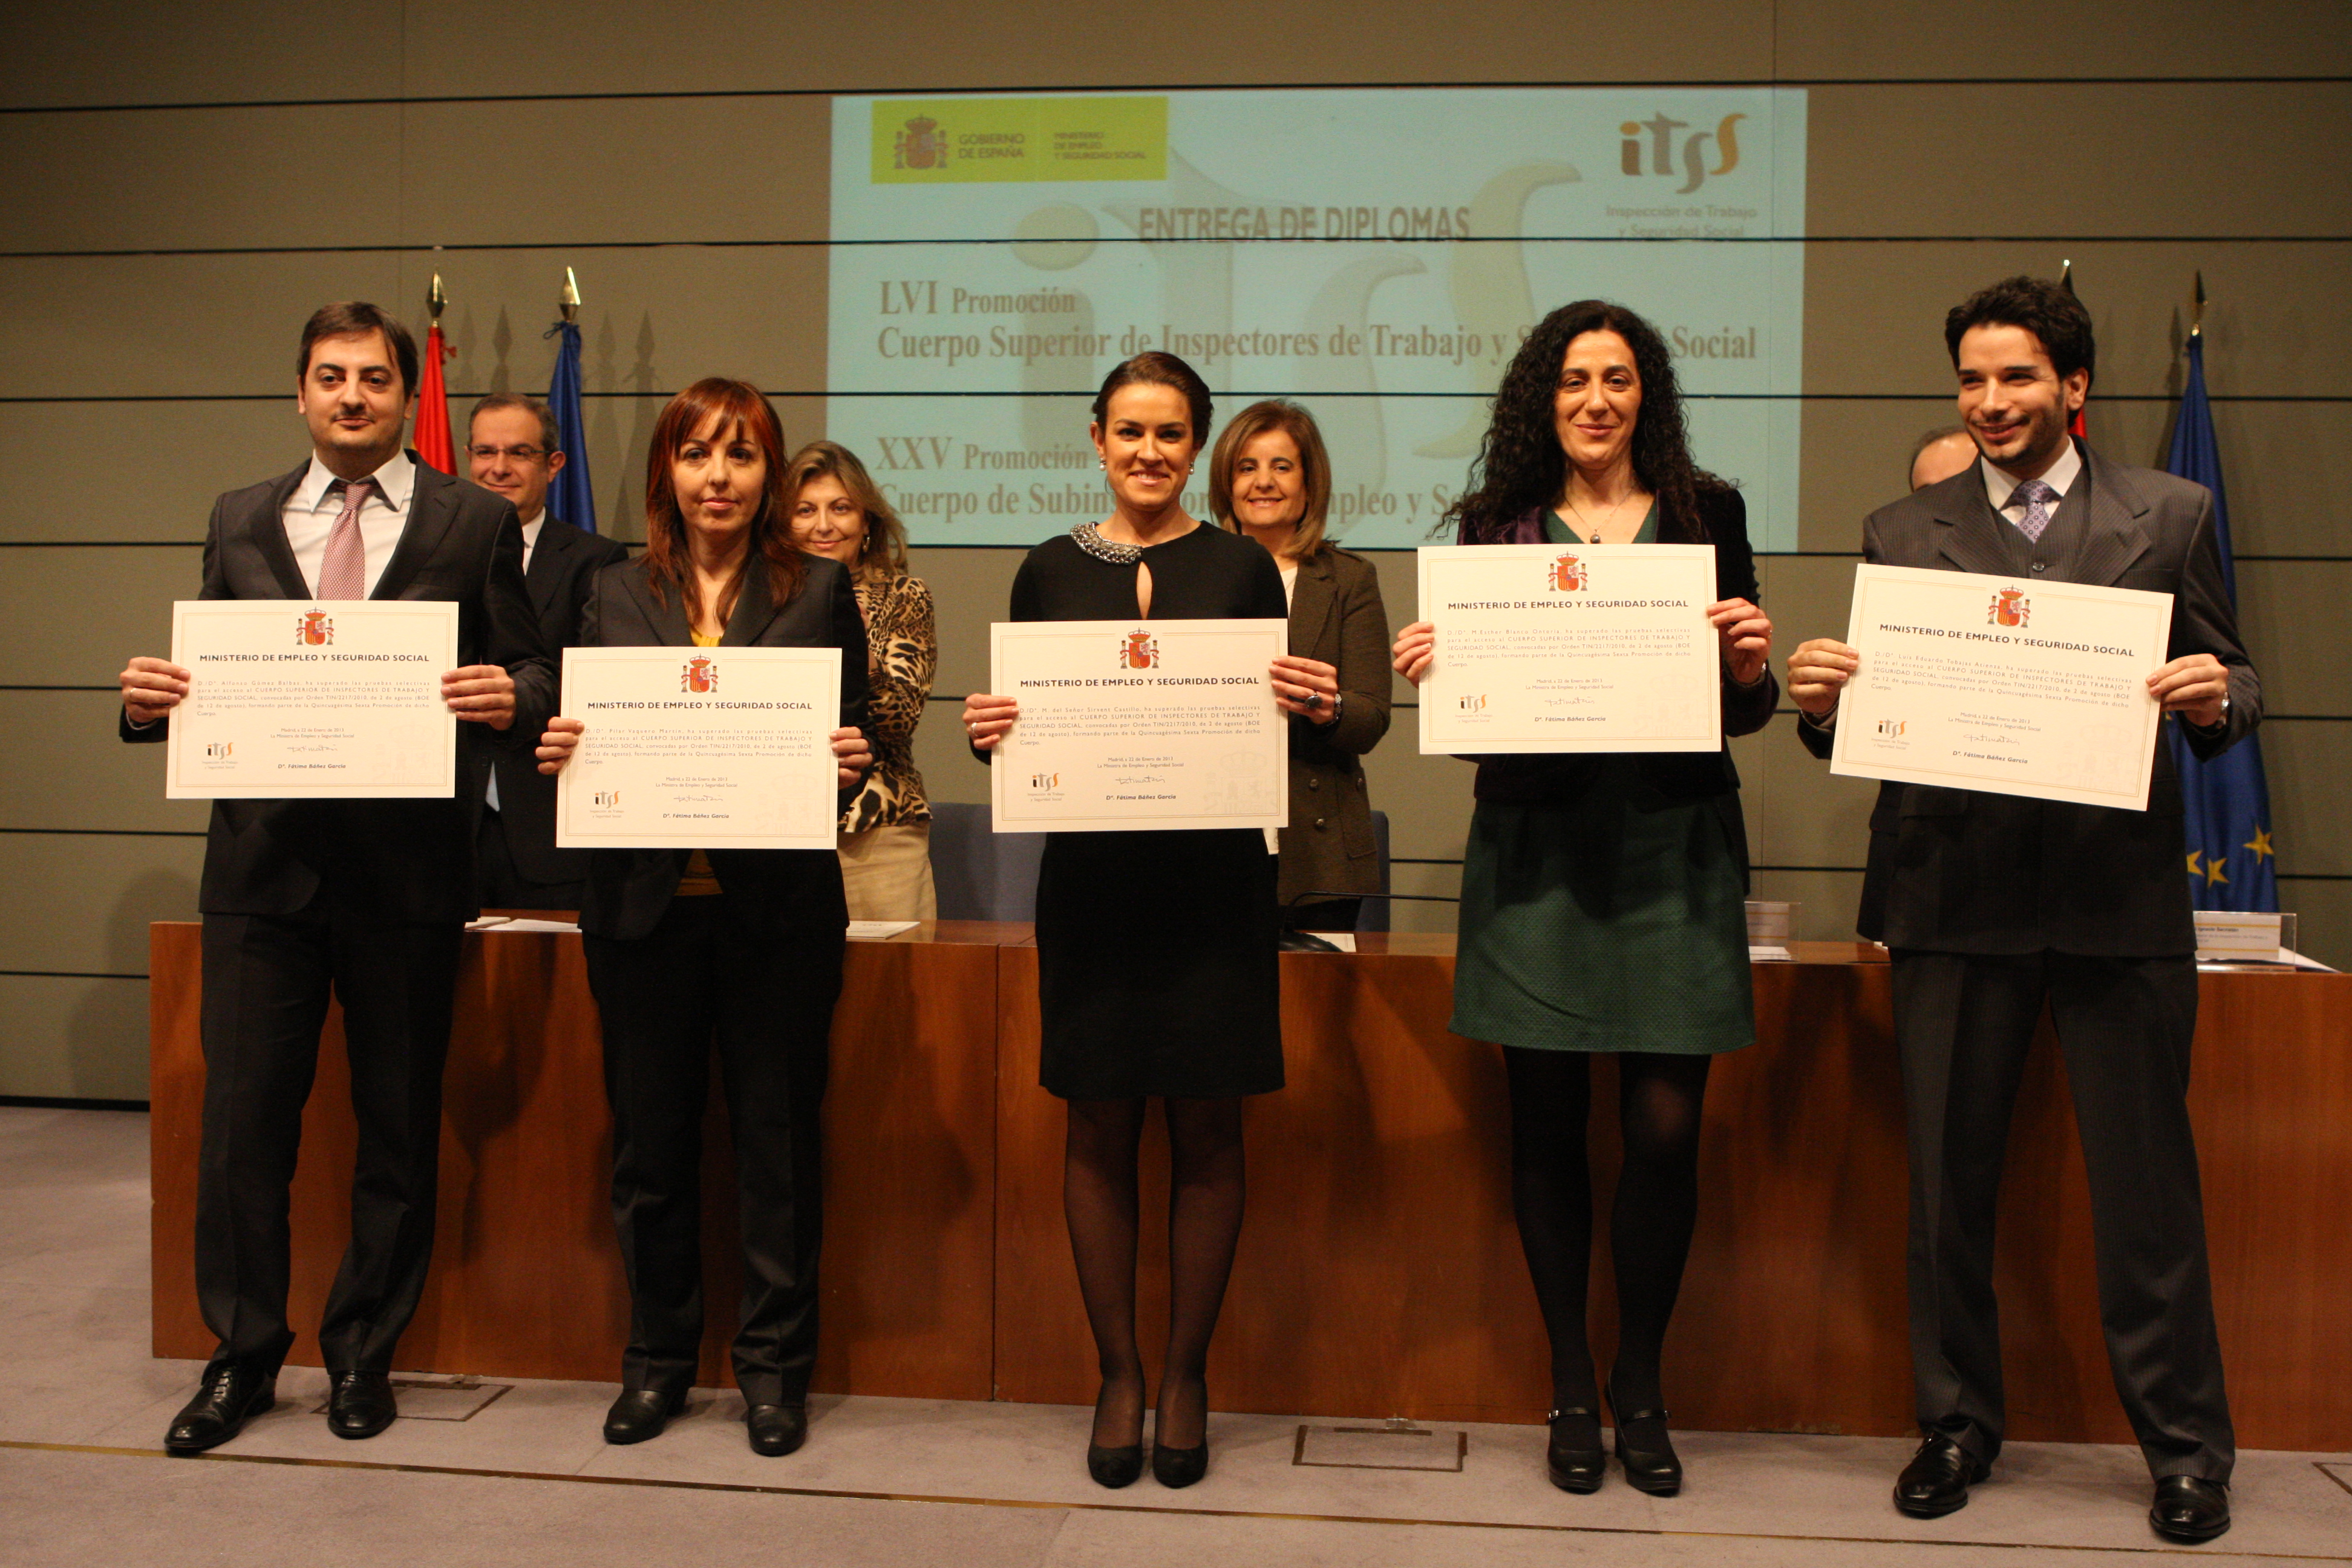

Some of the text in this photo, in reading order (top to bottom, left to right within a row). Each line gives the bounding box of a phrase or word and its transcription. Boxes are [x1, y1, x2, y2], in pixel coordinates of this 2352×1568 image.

[959, 133, 1025, 145] GOBIERNO
[959, 145, 1025, 158] DE ESPAÑA
[1139, 206, 1471, 240] ENTREGA DE DIPLOMAS
[880, 281, 1076, 315] LVI Promoción
[877, 325, 980, 366] Cuerpo
[990, 325, 1111, 365] Superior
[1120, 325, 1152, 356] de
[1163, 324, 1319, 364] Inspectores
[1331, 325, 1361, 356] de
[1370, 325, 1483, 365] Trabajo
[1491, 334, 1507, 365] y
[1671, 325, 1756, 359] Social
[875, 436, 1088, 470] XXV Promoción
[988, 483, 1021, 515] de
[1406, 493, 1423, 524] y
[1448, 601, 1511, 610] MINISTERIO
[1880, 623, 1945, 637] MINISTERIO
[1947, 630, 1962, 639] DE
[1965, 632, 2010, 644] EMPLEO
[2024, 638, 2090, 652] SEGURIDAD
[2093, 645, 2135, 657] SOCIAL
[1020, 679, 1082, 688] MINISTERIO
[1102, 678, 1144, 687] EMPLEO
[1157, 678, 1218, 686] SEGURIDAD
[1873, 667, 1911, 676] SEGURIDAD
[1915, 655, 1944, 664] Eduardo
[2097, 675, 2132, 684] selectivas
[1936, 665, 1967, 673] CUERPO
[1970, 668, 2006, 678] SUPERIOR
[2023, 675, 2073, 685] INSPECTORES
[2089, 681, 2124, 691] TRABAJO
